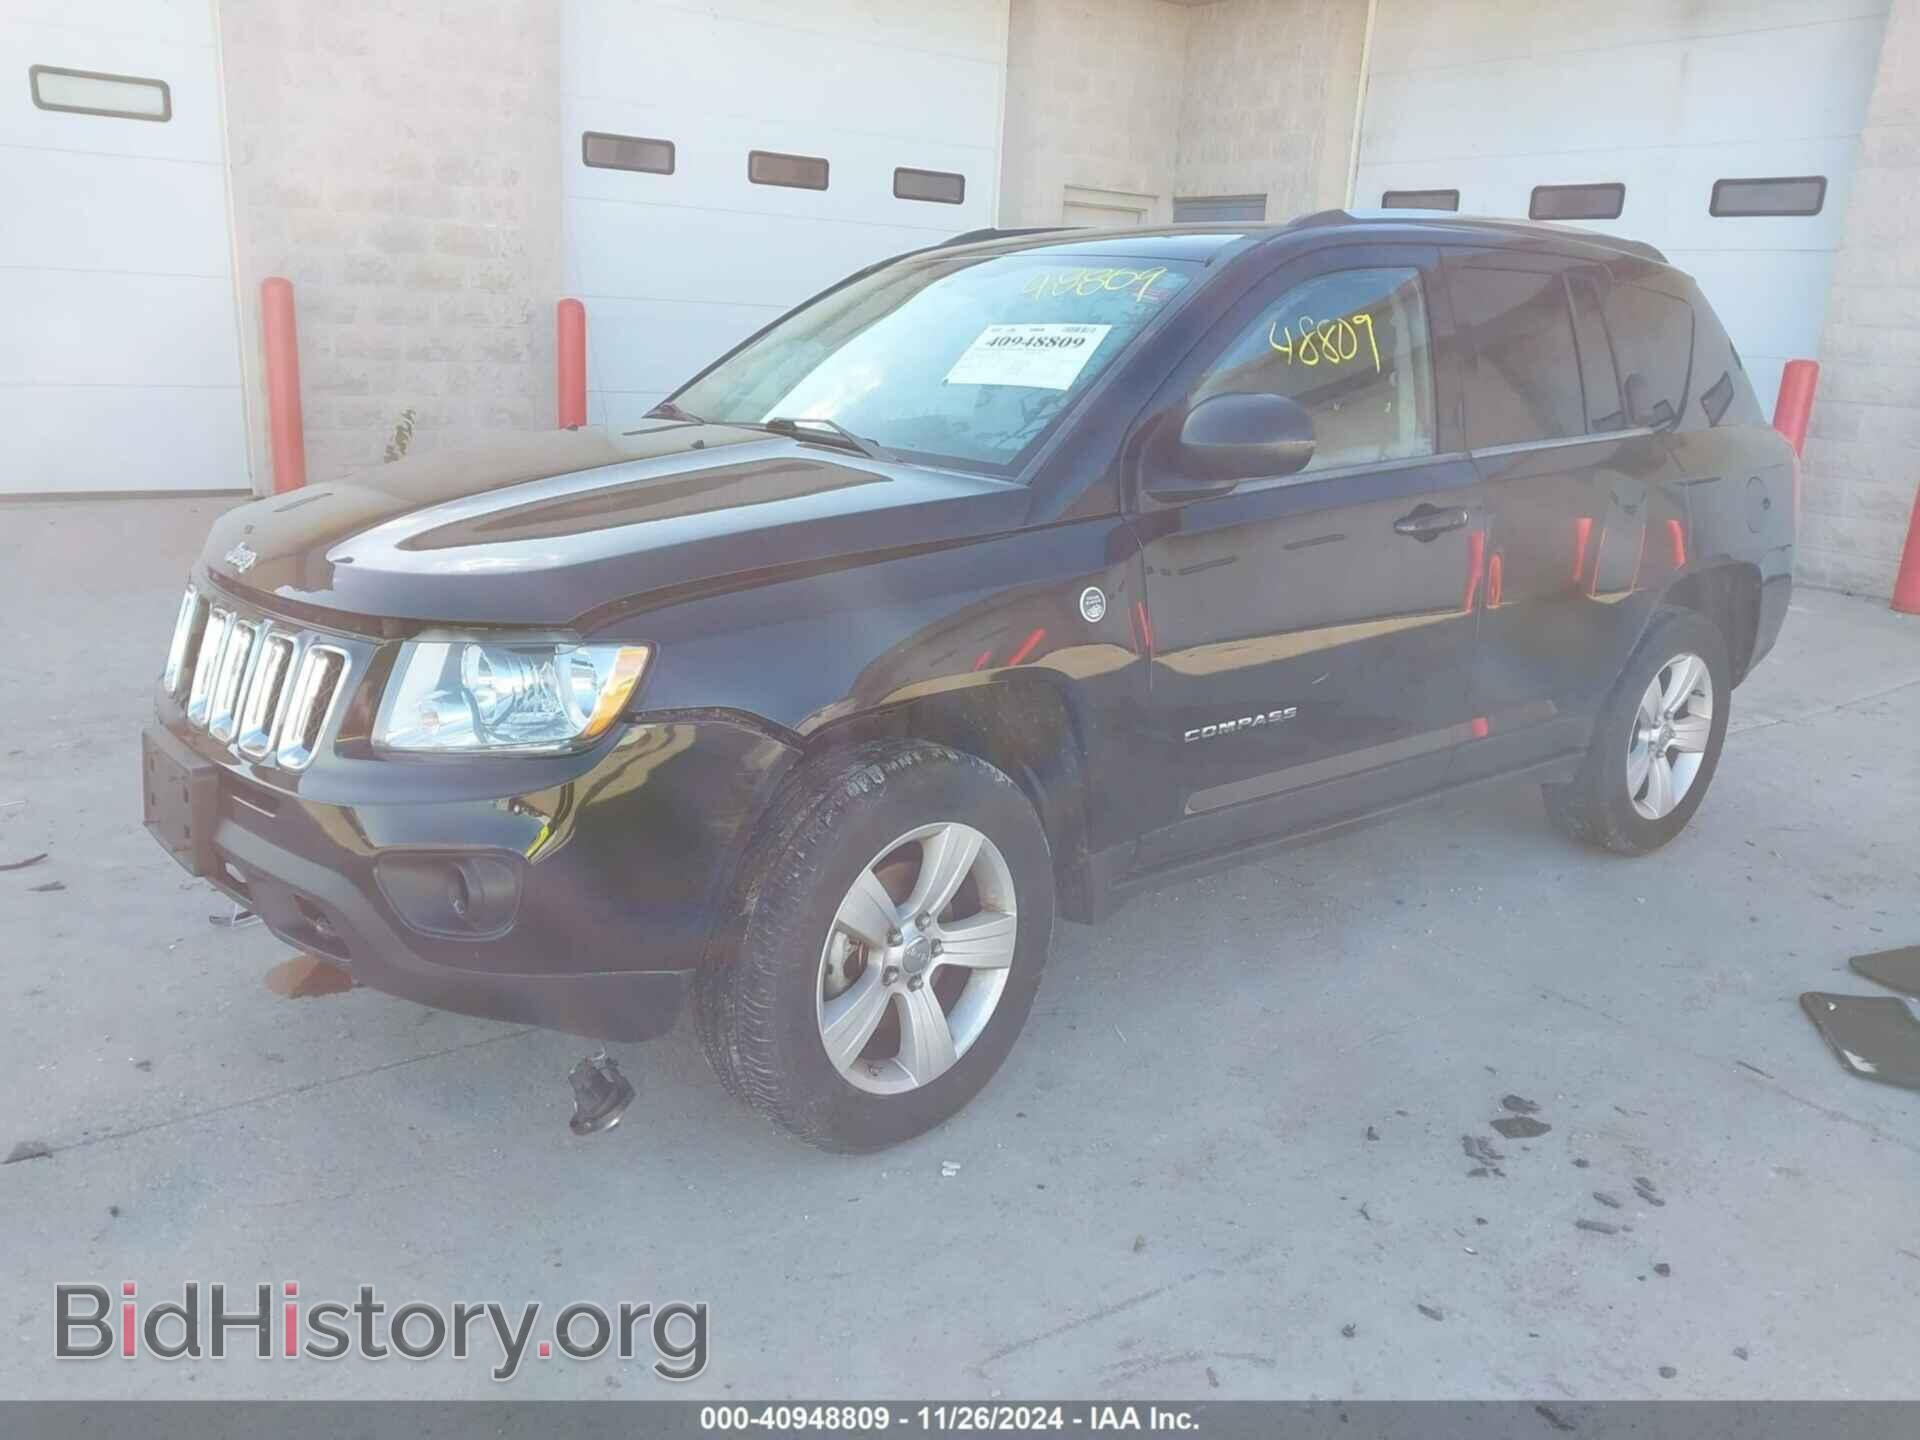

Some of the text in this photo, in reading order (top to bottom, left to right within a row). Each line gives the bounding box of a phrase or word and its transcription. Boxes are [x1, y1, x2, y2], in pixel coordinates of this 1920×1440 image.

[986, 336, 1086, 349] 40948809
[1269, 314, 1381, 374] 48809
[1184, 707, 1298, 743] COMPASS
